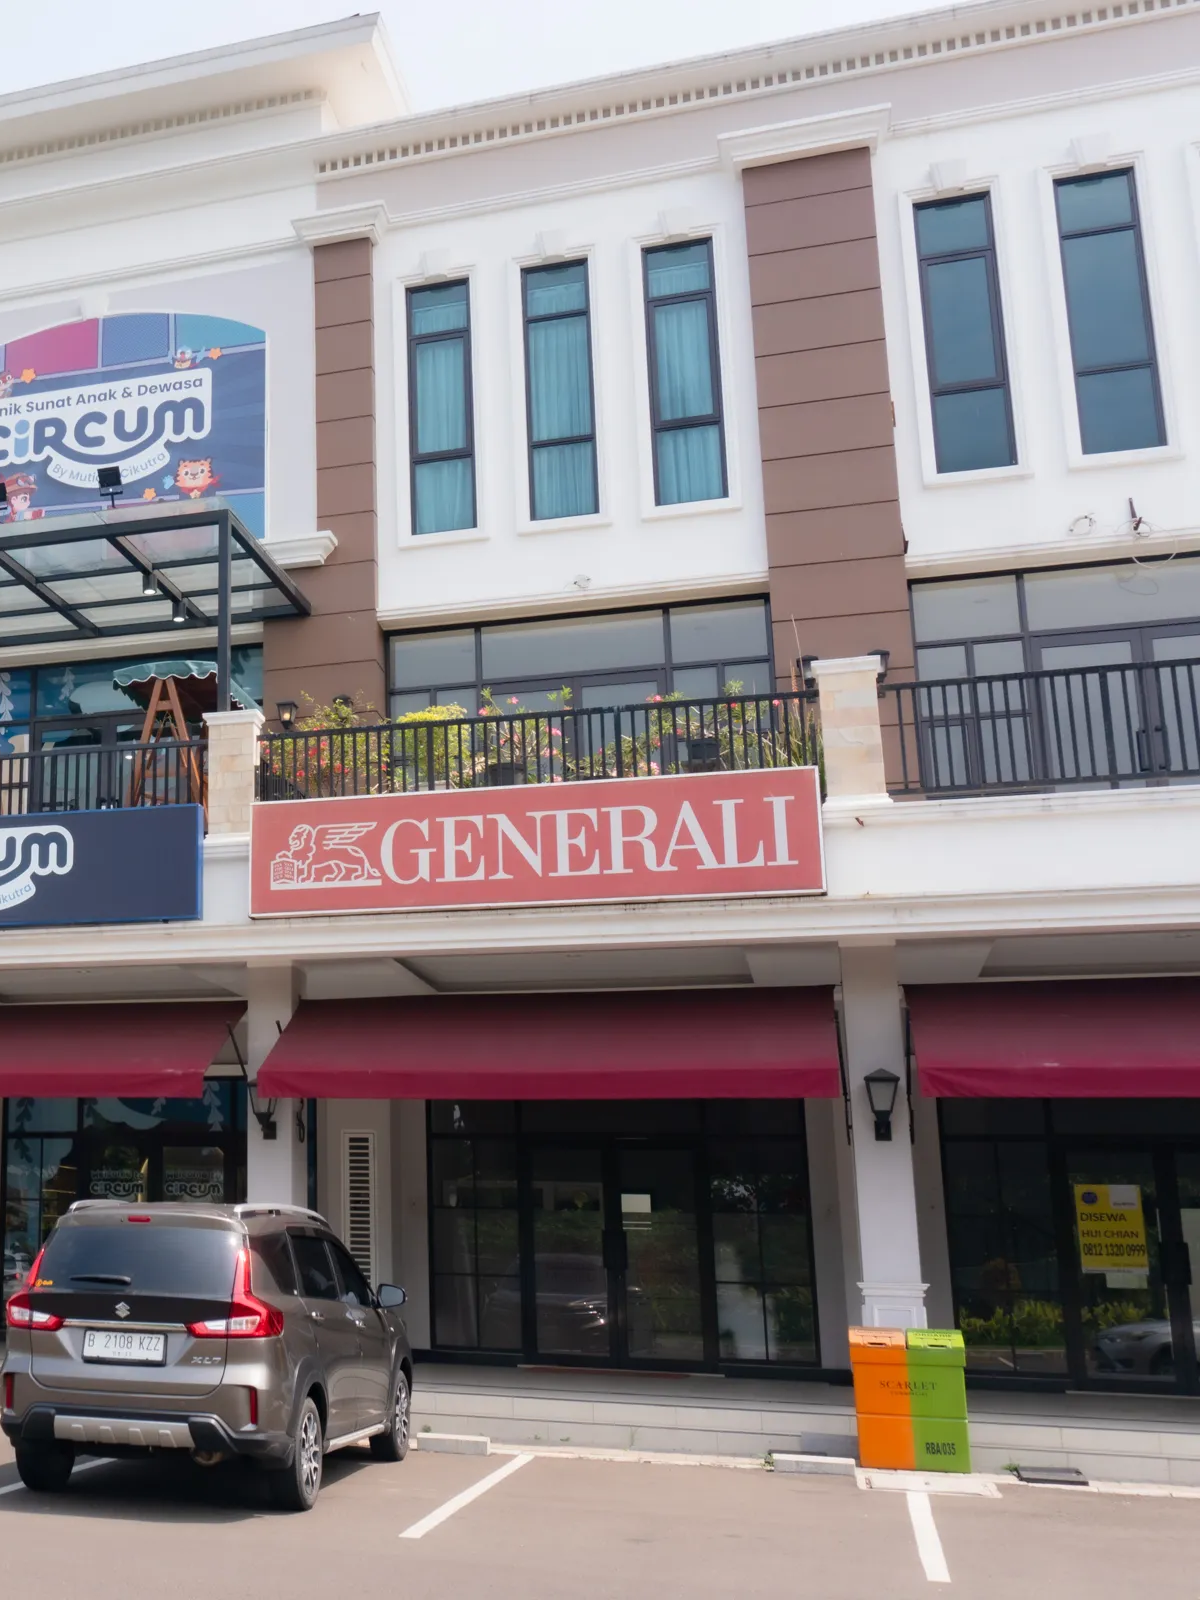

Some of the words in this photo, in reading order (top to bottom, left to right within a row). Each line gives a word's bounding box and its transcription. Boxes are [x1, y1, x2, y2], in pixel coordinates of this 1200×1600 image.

[26, 396, 72, 413] Sunat
[76, 389, 117, 405] Anak
[121, 386, 133, 399] &
[137, 377, 204, 397] Dewasa
[52, 464, 65, 479] By
[379, 796, 799, 885] GENERALI
[1080, 1212, 1128, 1222] DISEWA
[1082, 1229, 1102, 1239] HUI
[1104, 1230, 1139, 1239] CHIAN
[88, 1333, 96, 1348] B
[104, 1334, 134, 1350] 2108
[139, 1337, 161, 1351] KZZ
[880, 1381, 938, 1391] SCARLET
